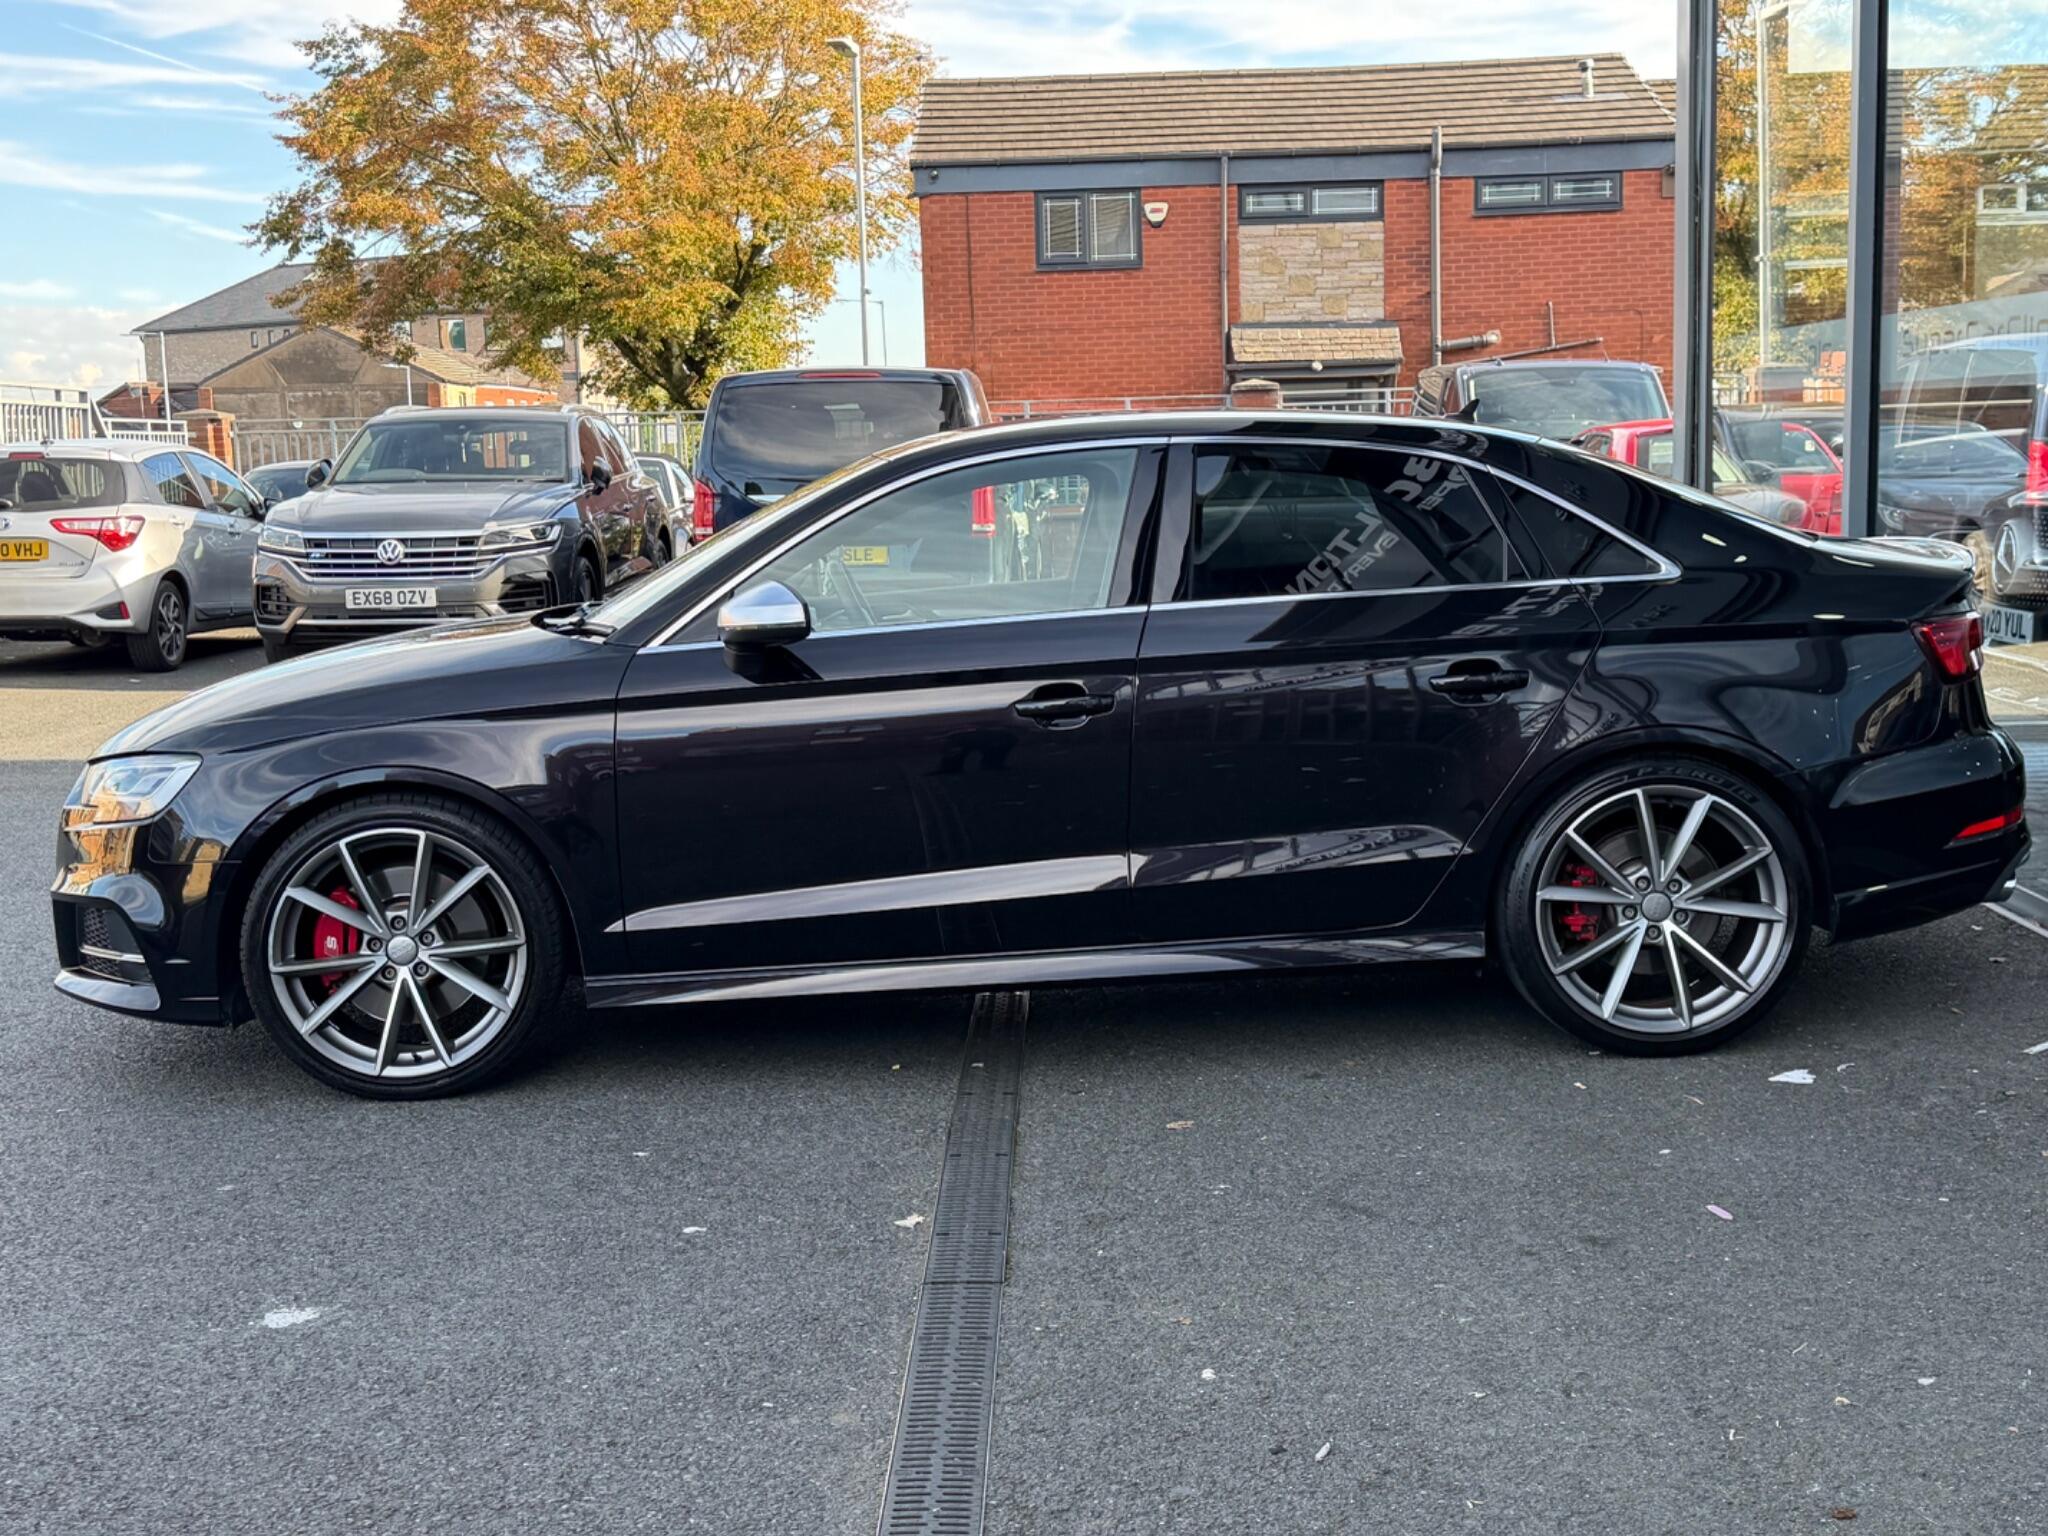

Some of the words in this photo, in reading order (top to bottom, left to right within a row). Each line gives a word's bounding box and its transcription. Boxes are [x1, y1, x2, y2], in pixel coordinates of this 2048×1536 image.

[14, 543, 42, 557] VHJ
[843, 548, 873, 561] SLE
[352, 591, 393, 606] EX68
[396, 590, 427, 605] OZV
[2004, 611, 2026, 640] YUL
